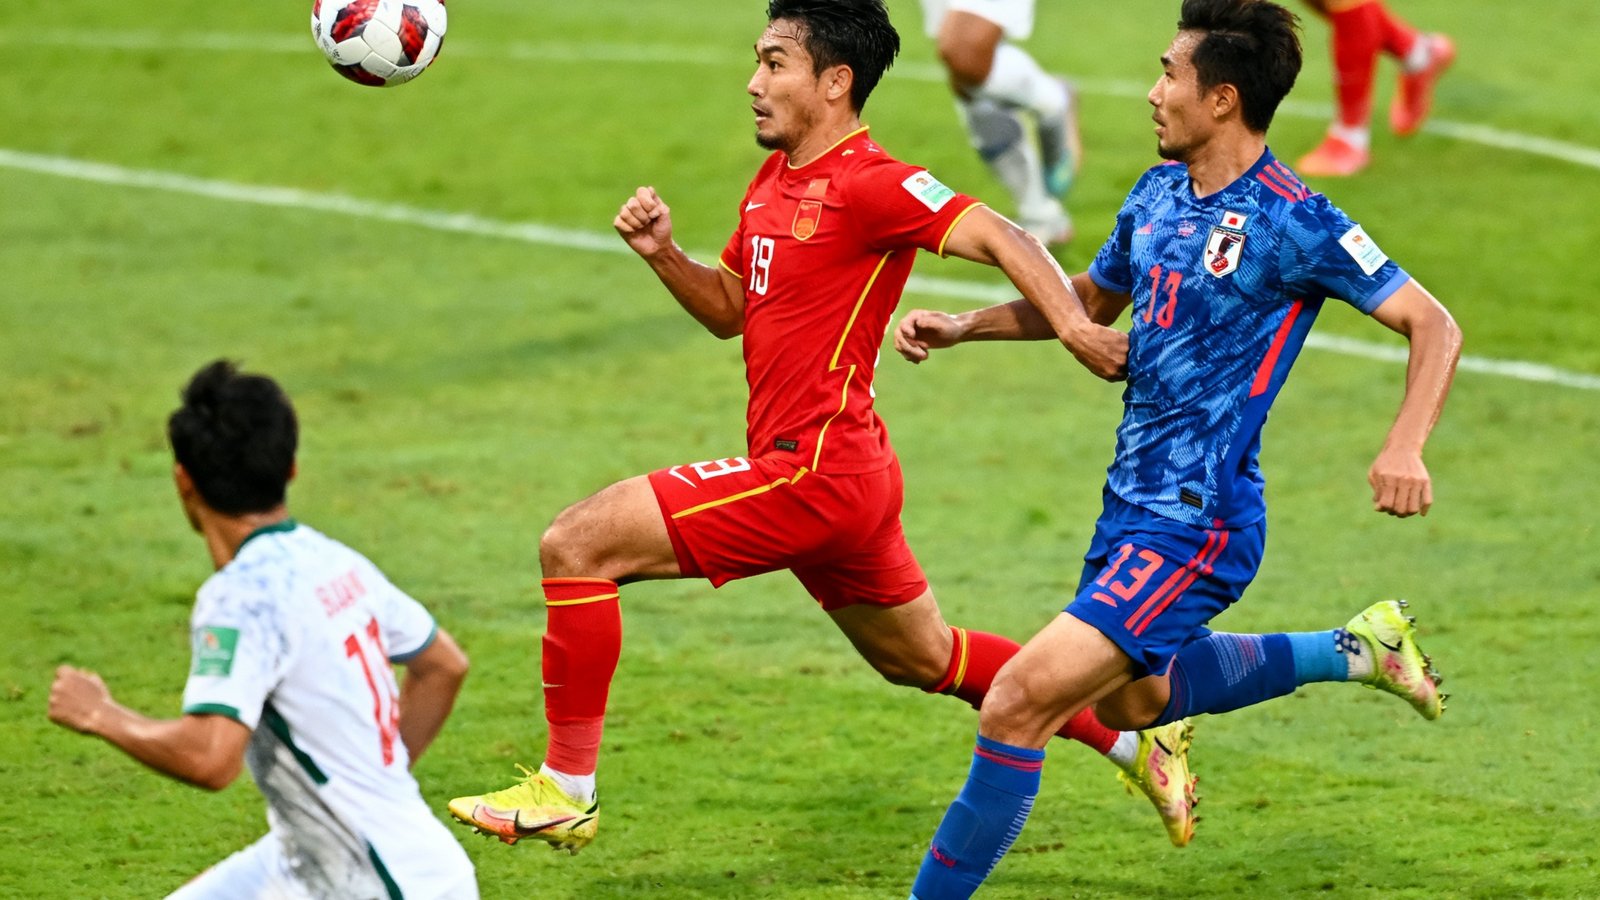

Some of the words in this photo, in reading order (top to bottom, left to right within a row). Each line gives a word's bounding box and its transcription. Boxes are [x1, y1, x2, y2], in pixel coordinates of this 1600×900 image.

[749, 235, 775, 296] 19
[1143, 264, 1183, 330] 13
[1096, 543, 1165, 602] 13
